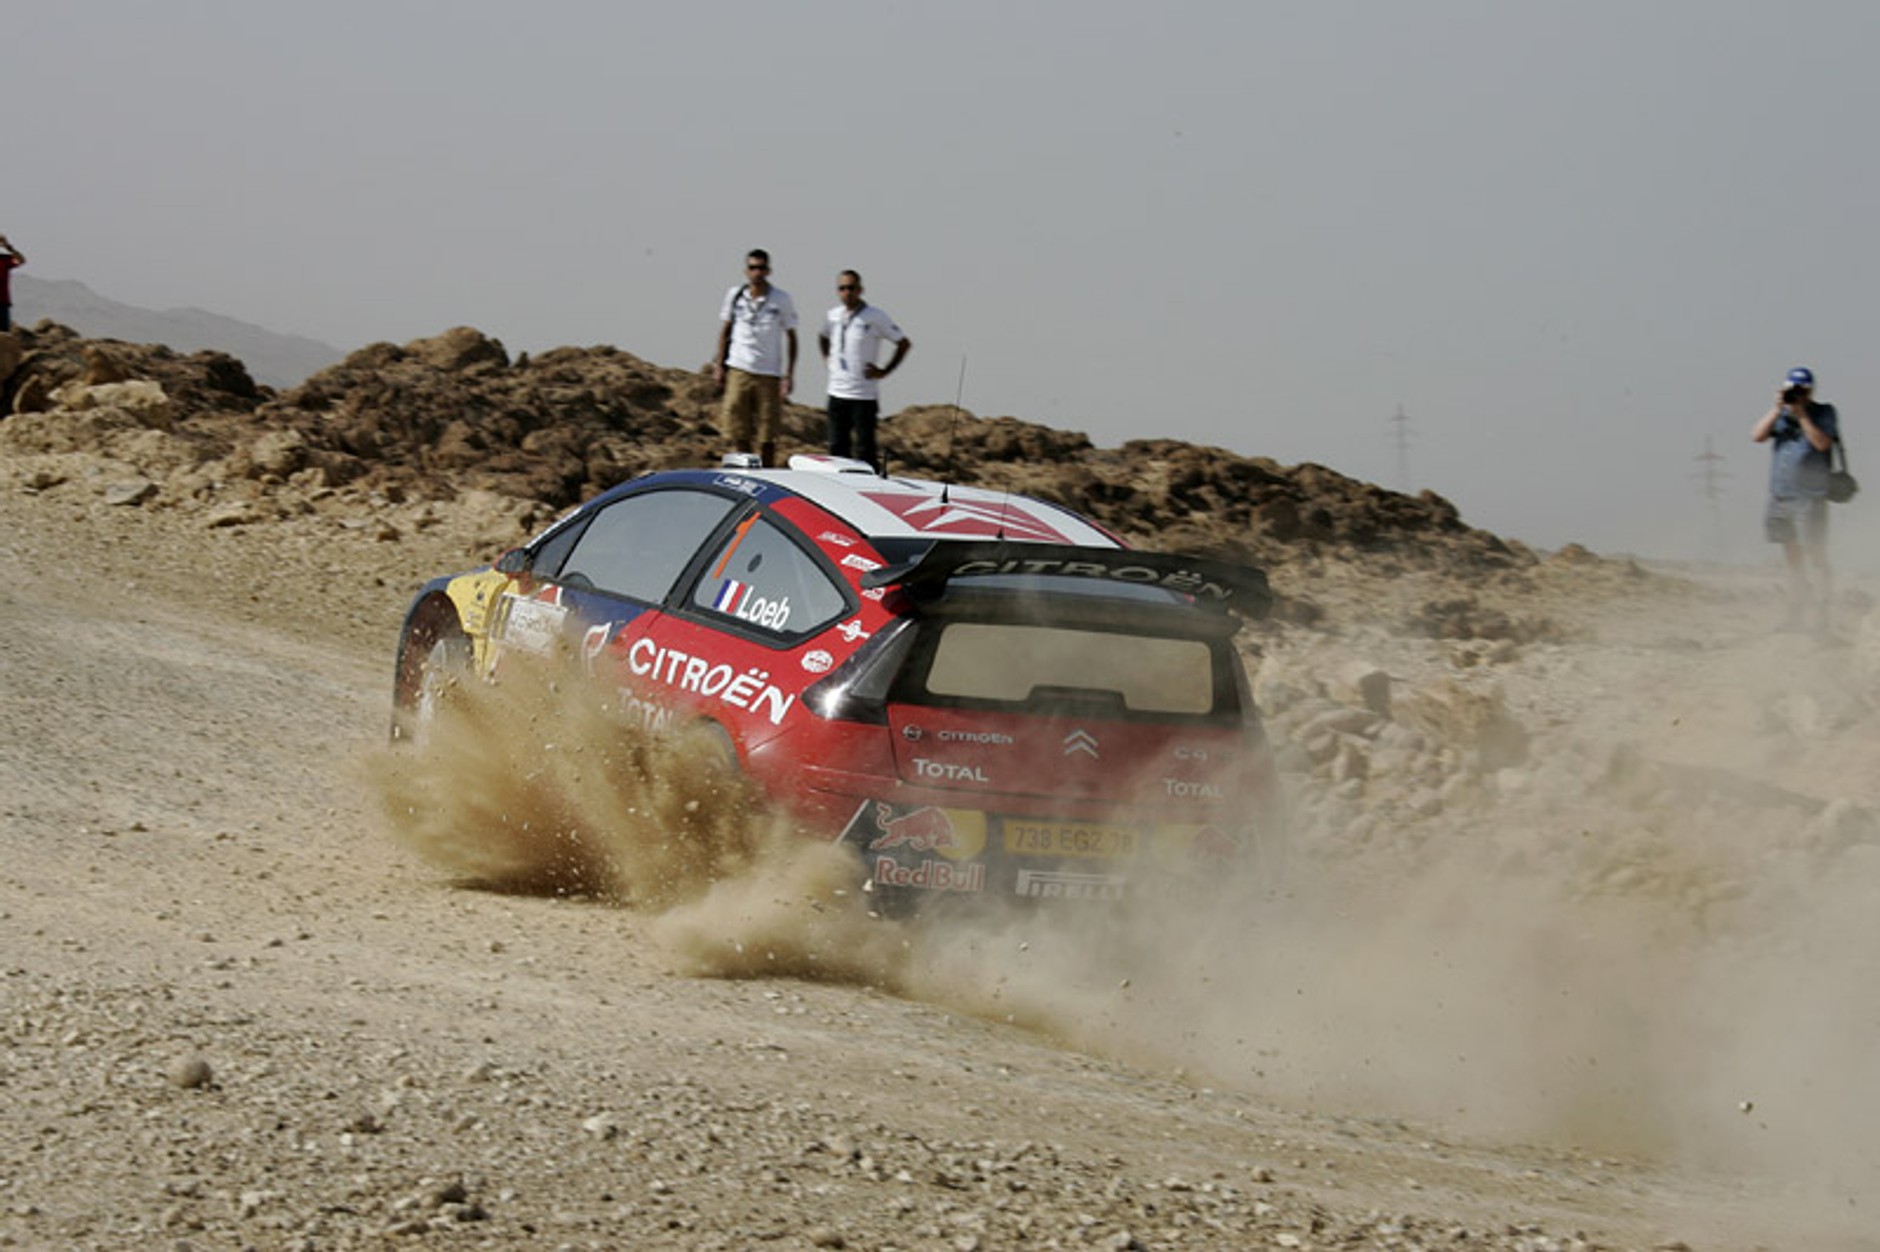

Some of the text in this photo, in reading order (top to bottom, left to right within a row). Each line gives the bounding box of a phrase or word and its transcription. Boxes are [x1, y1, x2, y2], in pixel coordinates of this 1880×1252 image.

[953, 561, 1232, 600] CITROËN
[736, 585, 790, 631] Loeb
[629, 638, 795, 726] CITROËN
[912, 758, 990, 782] TOTAL
[1163, 778, 1224, 798] TOTAL
[1014, 827, 1053, 850] 738
[876, 856, 986, 892] Red Bull
[1015, 868, 1126, 899] PIRELLI
